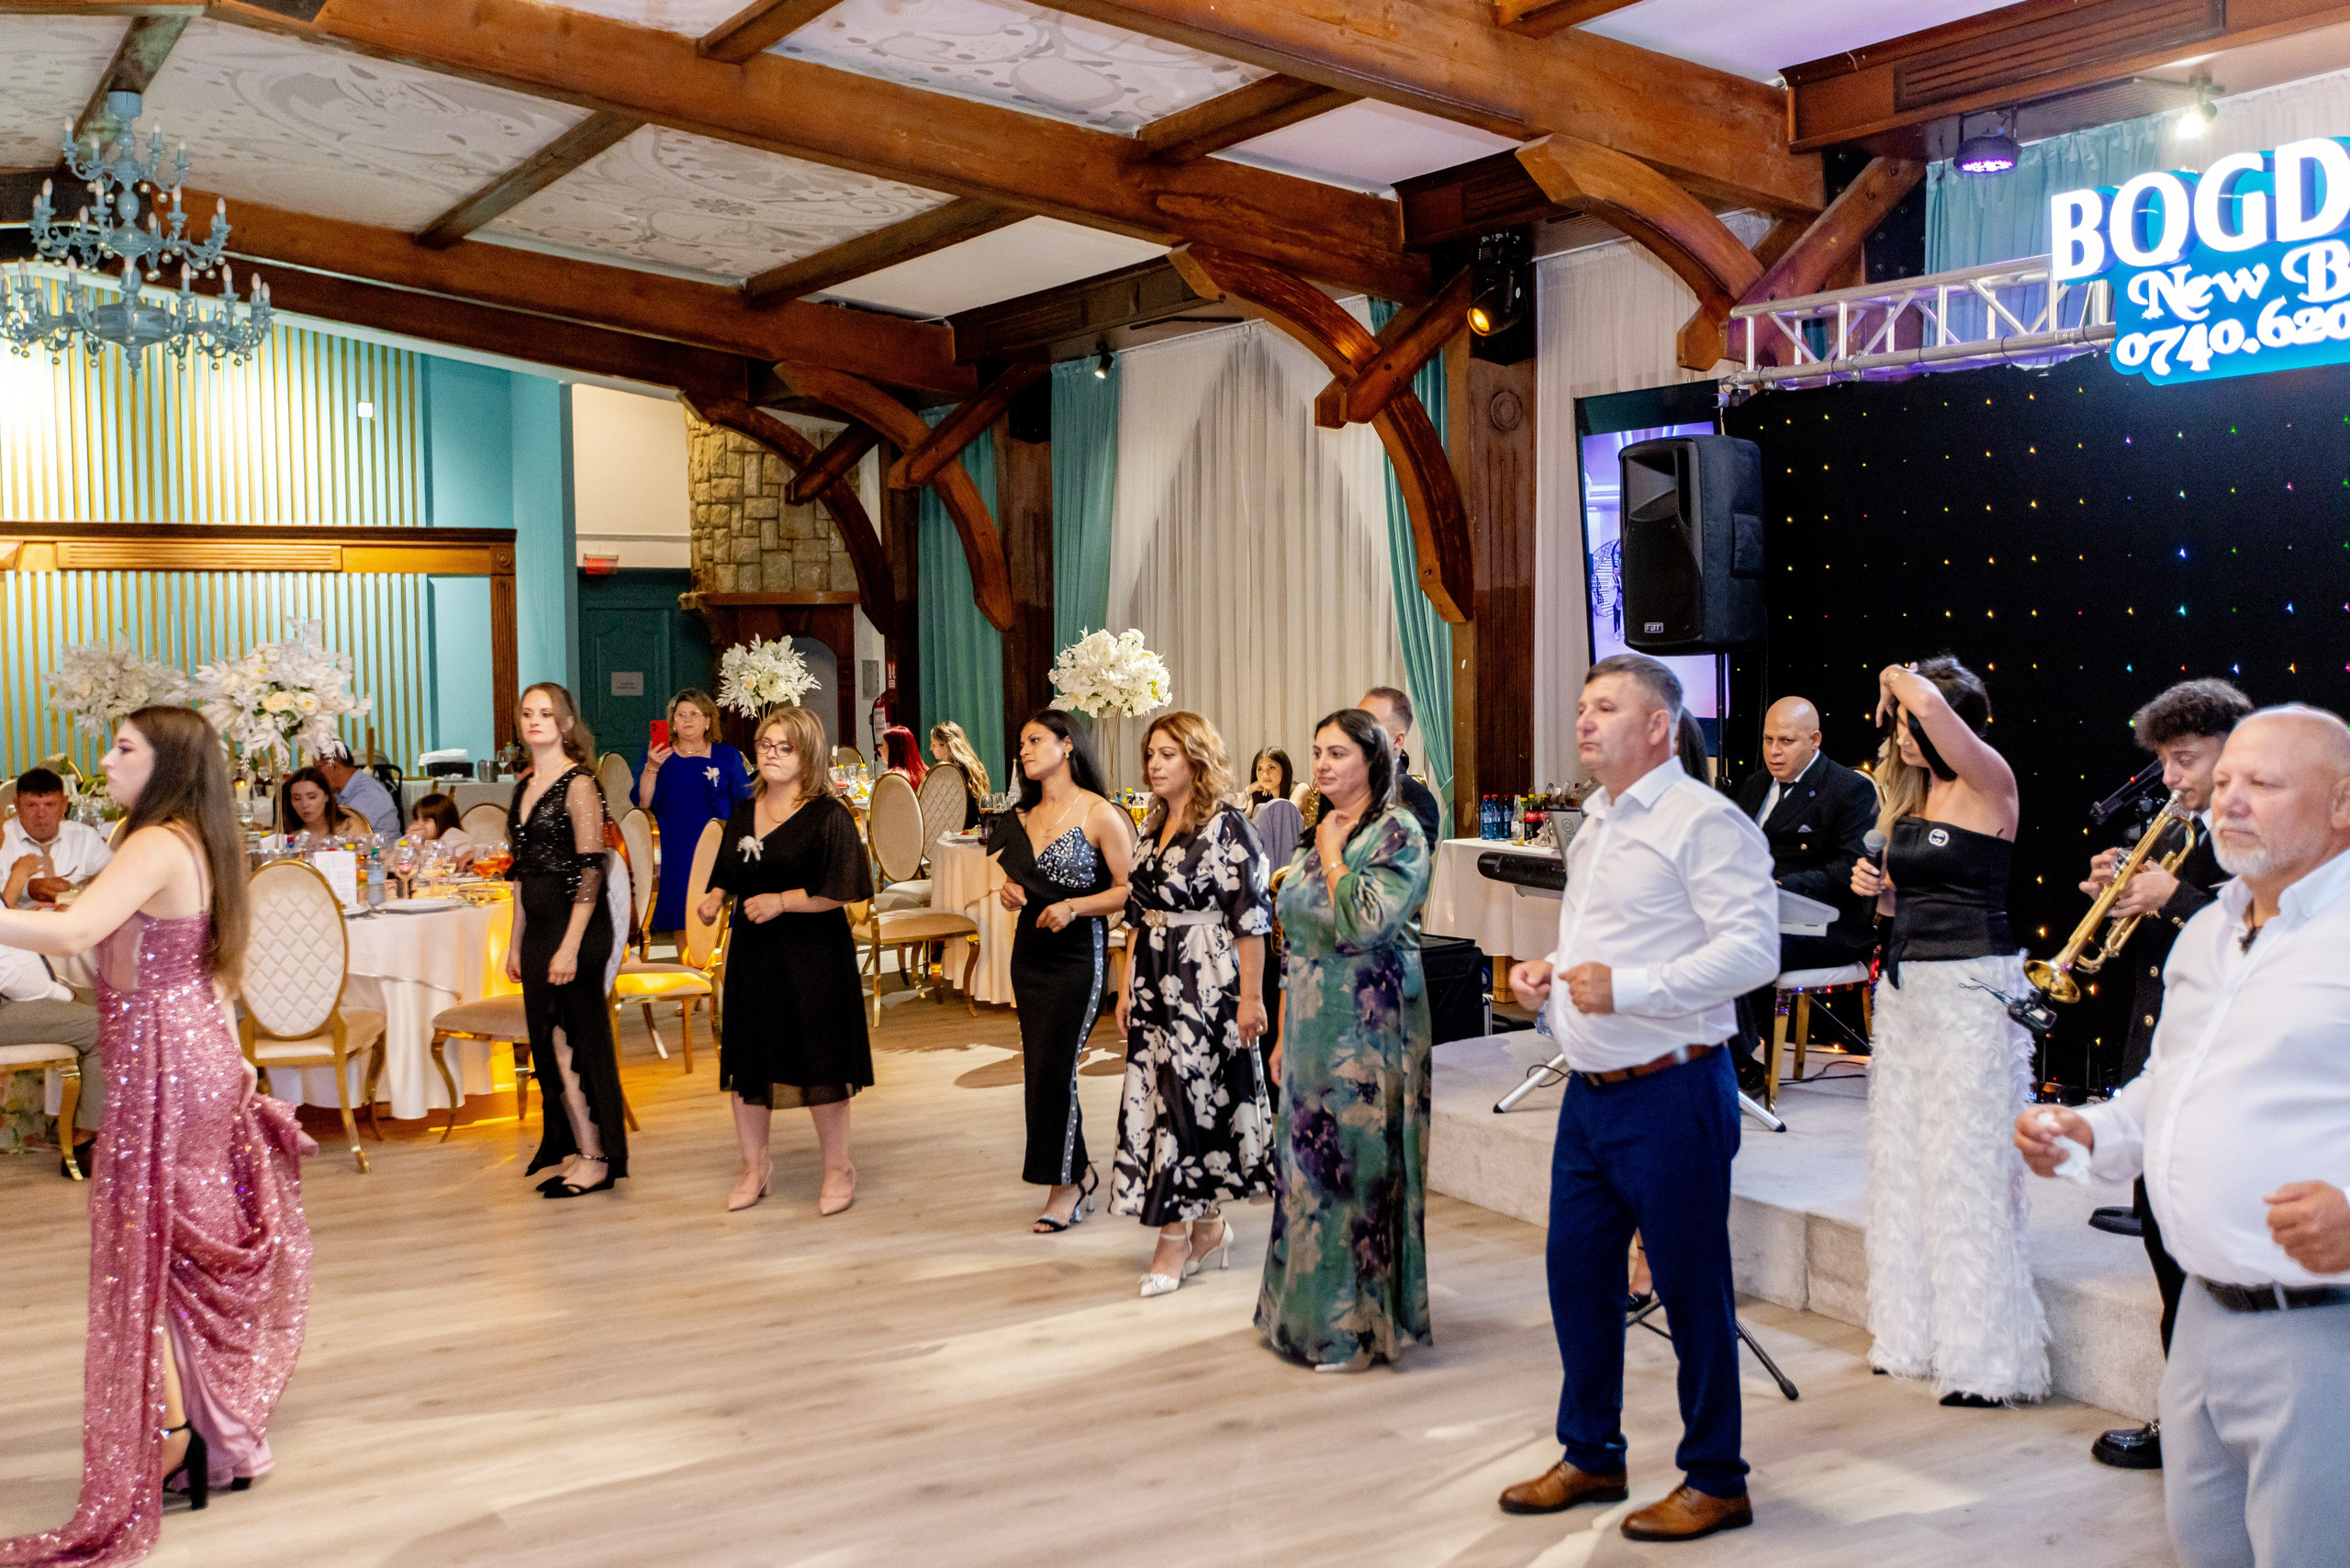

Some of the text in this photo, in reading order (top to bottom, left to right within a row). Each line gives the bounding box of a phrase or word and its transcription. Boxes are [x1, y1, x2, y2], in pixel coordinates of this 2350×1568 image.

[2051, 138, 2350, 281] BOGD
[2127, 263, 2271, 321] New
[1646, 623, 1662, 632] FBT
